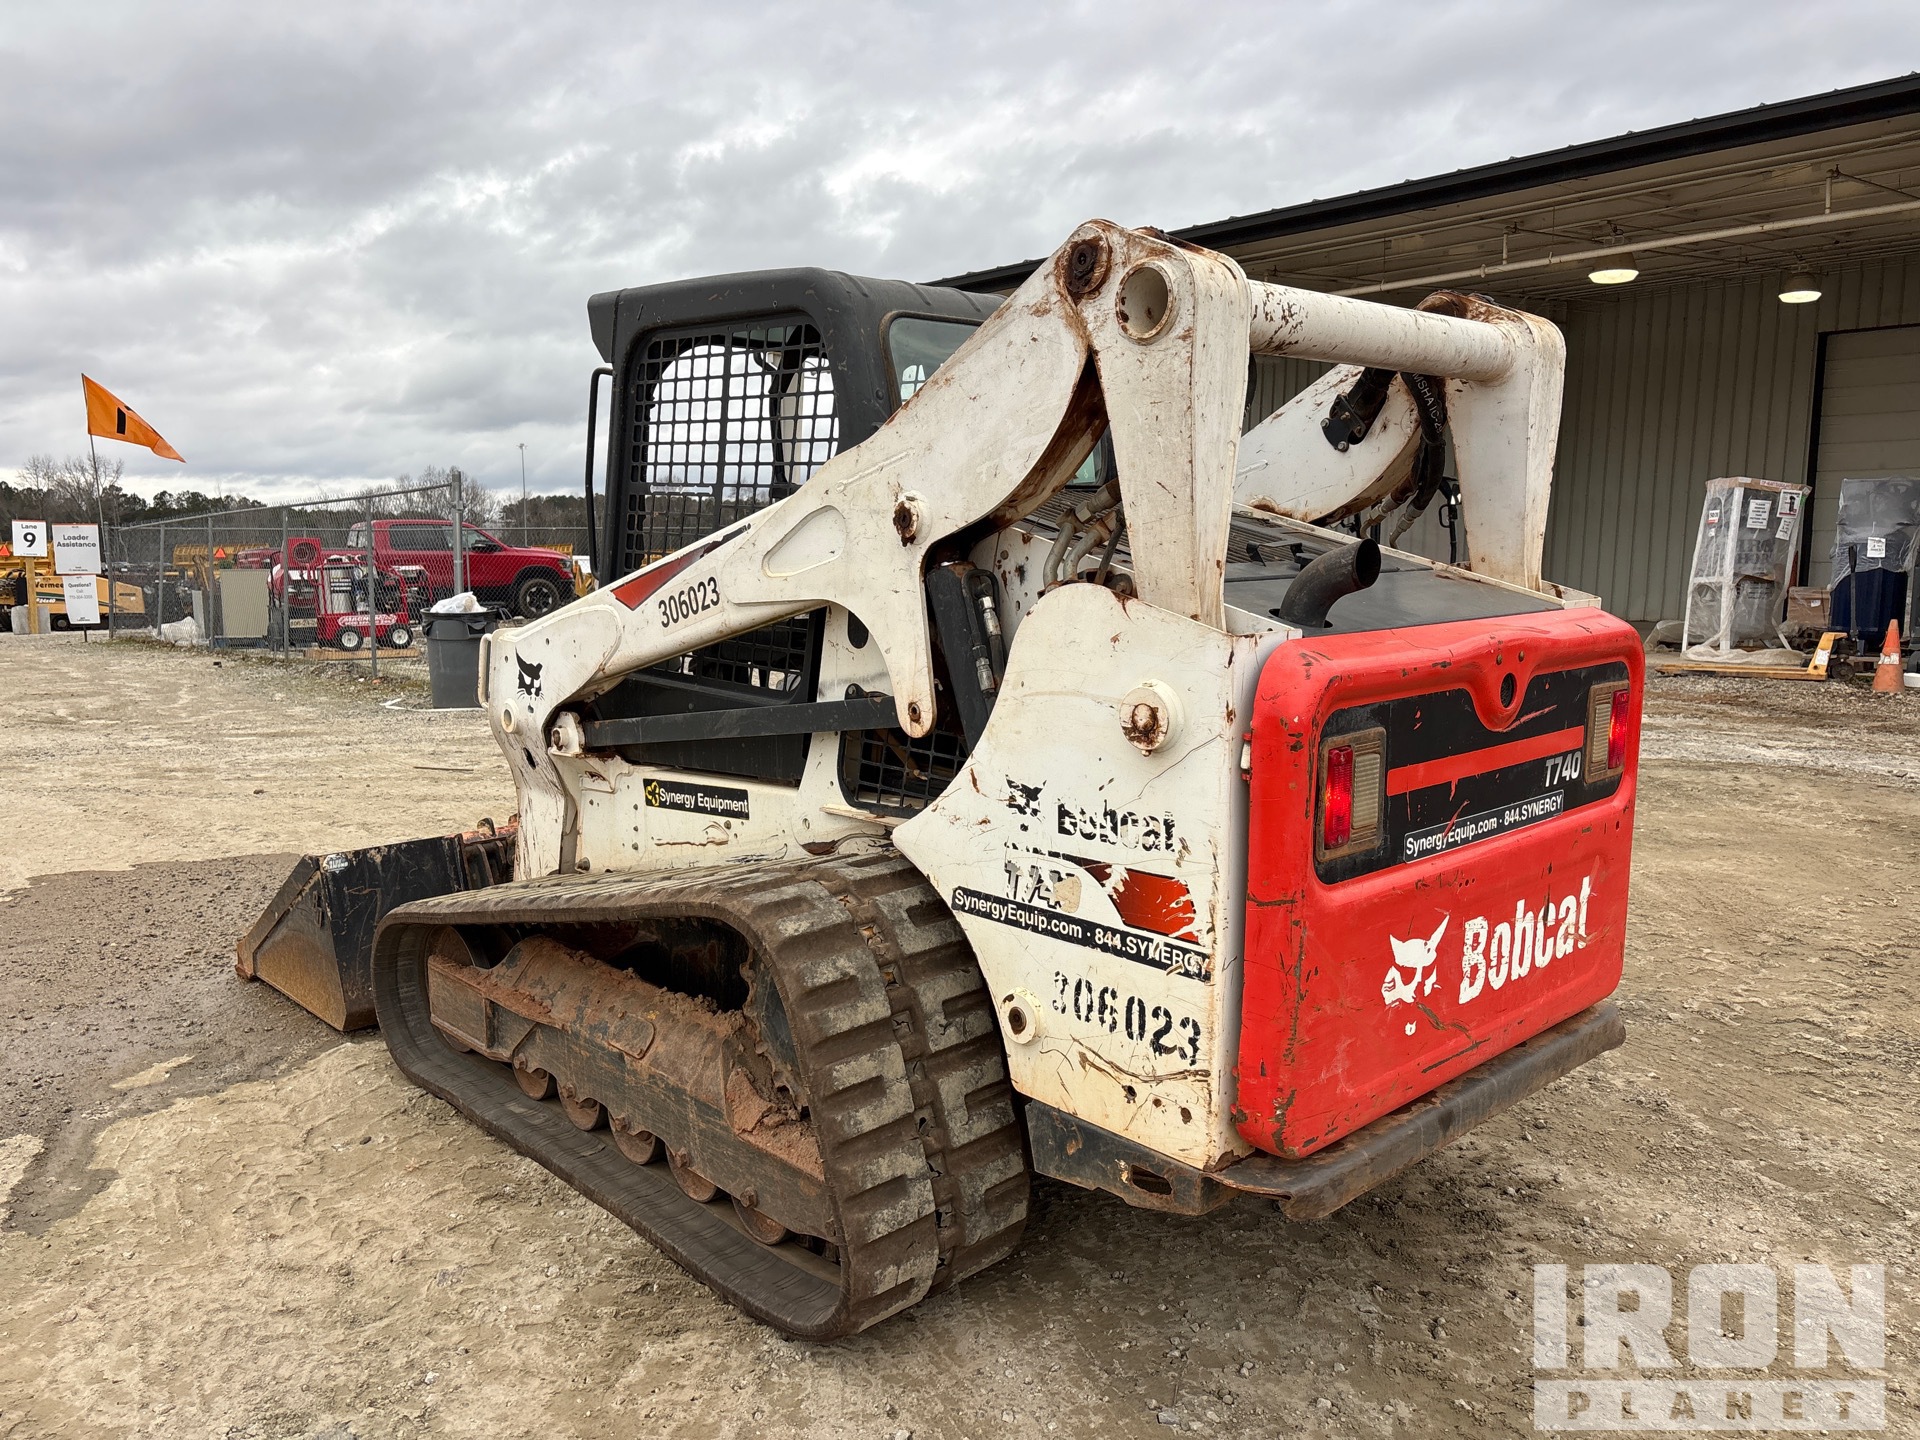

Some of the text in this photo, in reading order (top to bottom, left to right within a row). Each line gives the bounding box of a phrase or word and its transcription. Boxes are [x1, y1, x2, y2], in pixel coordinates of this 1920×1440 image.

[23, 532, 36, 548] 9
[658, 576, 721, 628] 306023
[1545, 751, 1581, 788] T740
[659, 787, 749, 813] Synergy Equipment
[1406, 794, 1563, 857] SynergyEquip.com 844.SYNERGY
[954, 889, 1083, 939] SynergyEquip.com
[1458, 875, 1590, 1005] Bobcat
[1052, 970, 1201, 1067] 306023
